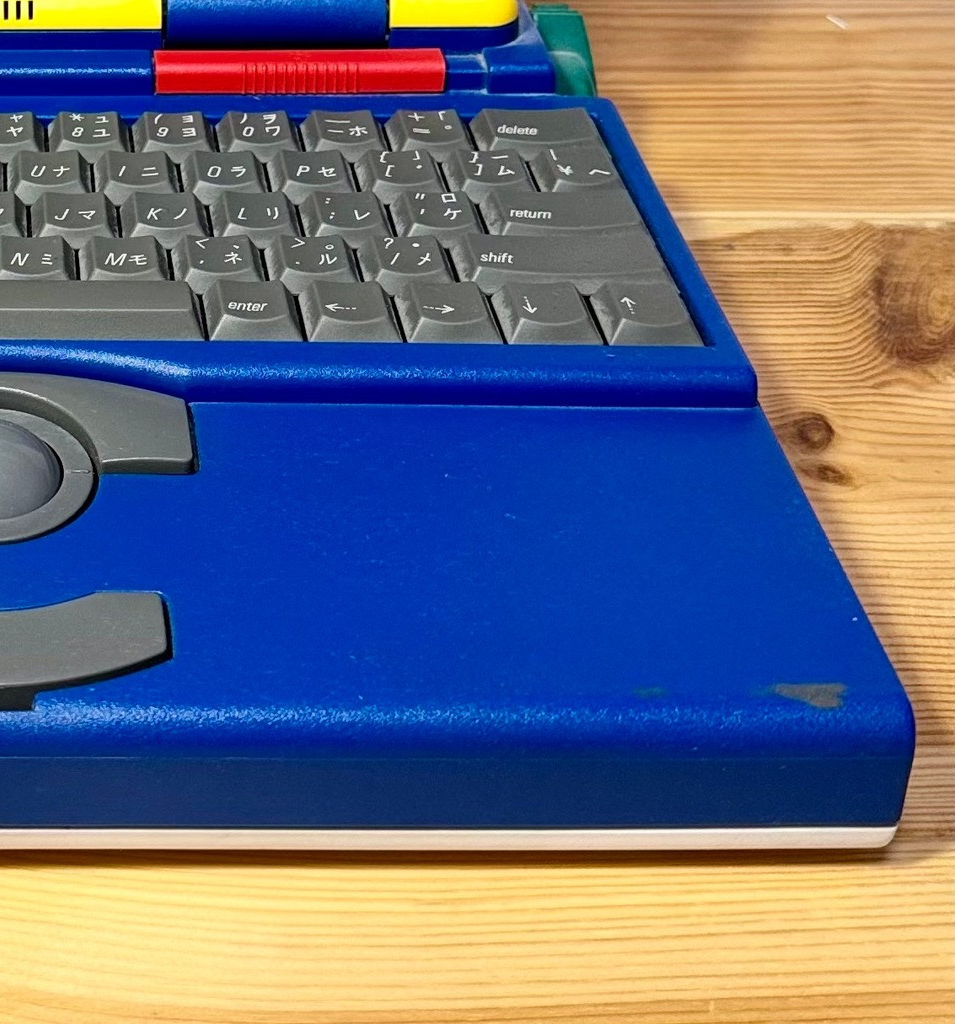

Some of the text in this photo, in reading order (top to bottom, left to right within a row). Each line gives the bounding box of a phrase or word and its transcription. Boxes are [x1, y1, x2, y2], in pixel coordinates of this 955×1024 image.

[71, 126, 84, 138] 8
[156, 126, 169, 137] 9
[497, 124, 538, 136] delete
[30, 165, 46, 178] U
[296, 165, 310, 177] P
[54, 208, 70, 221] J
[146, 207, 163, 221] K
[237, 207, 247, 220] L
[509, 209, 552, 219] return
[10, 252, 30, 266] N
[104, 252, 128, 266] M
[480, 251, 514, 264] shift
[227, 301, 268, 312] enter
